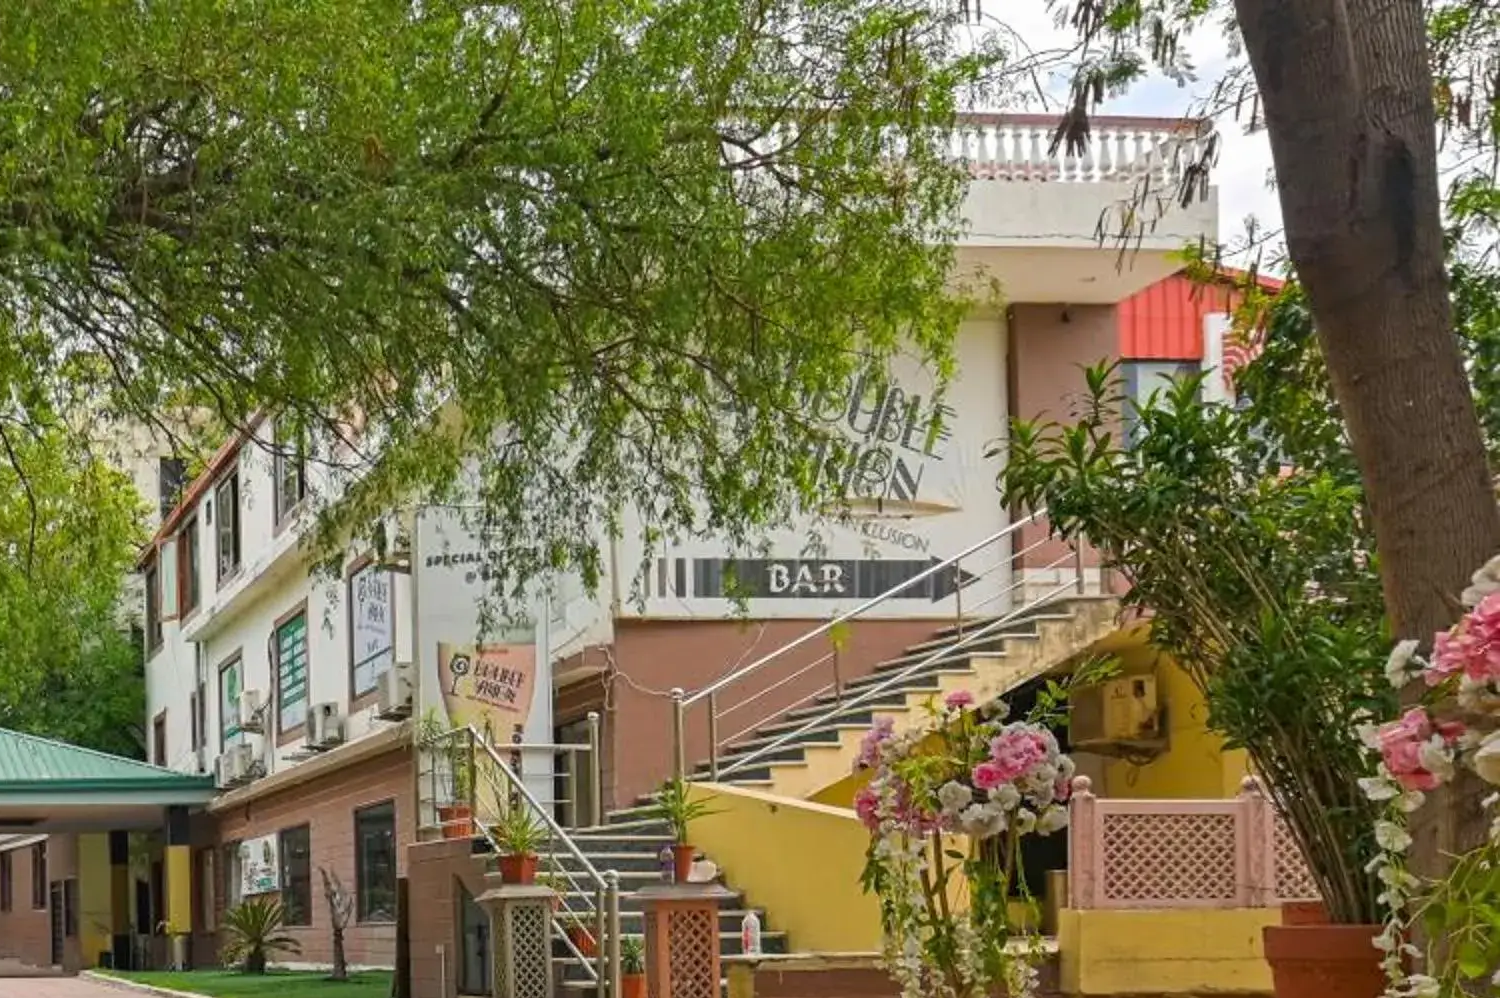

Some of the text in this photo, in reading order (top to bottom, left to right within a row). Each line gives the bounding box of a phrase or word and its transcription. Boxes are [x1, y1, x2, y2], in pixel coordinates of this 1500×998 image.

[796, 364, 958, 461] OUBLE
[426, 551, 483, 568] SPECIAL
[767, 563, 845, 594] BAR
